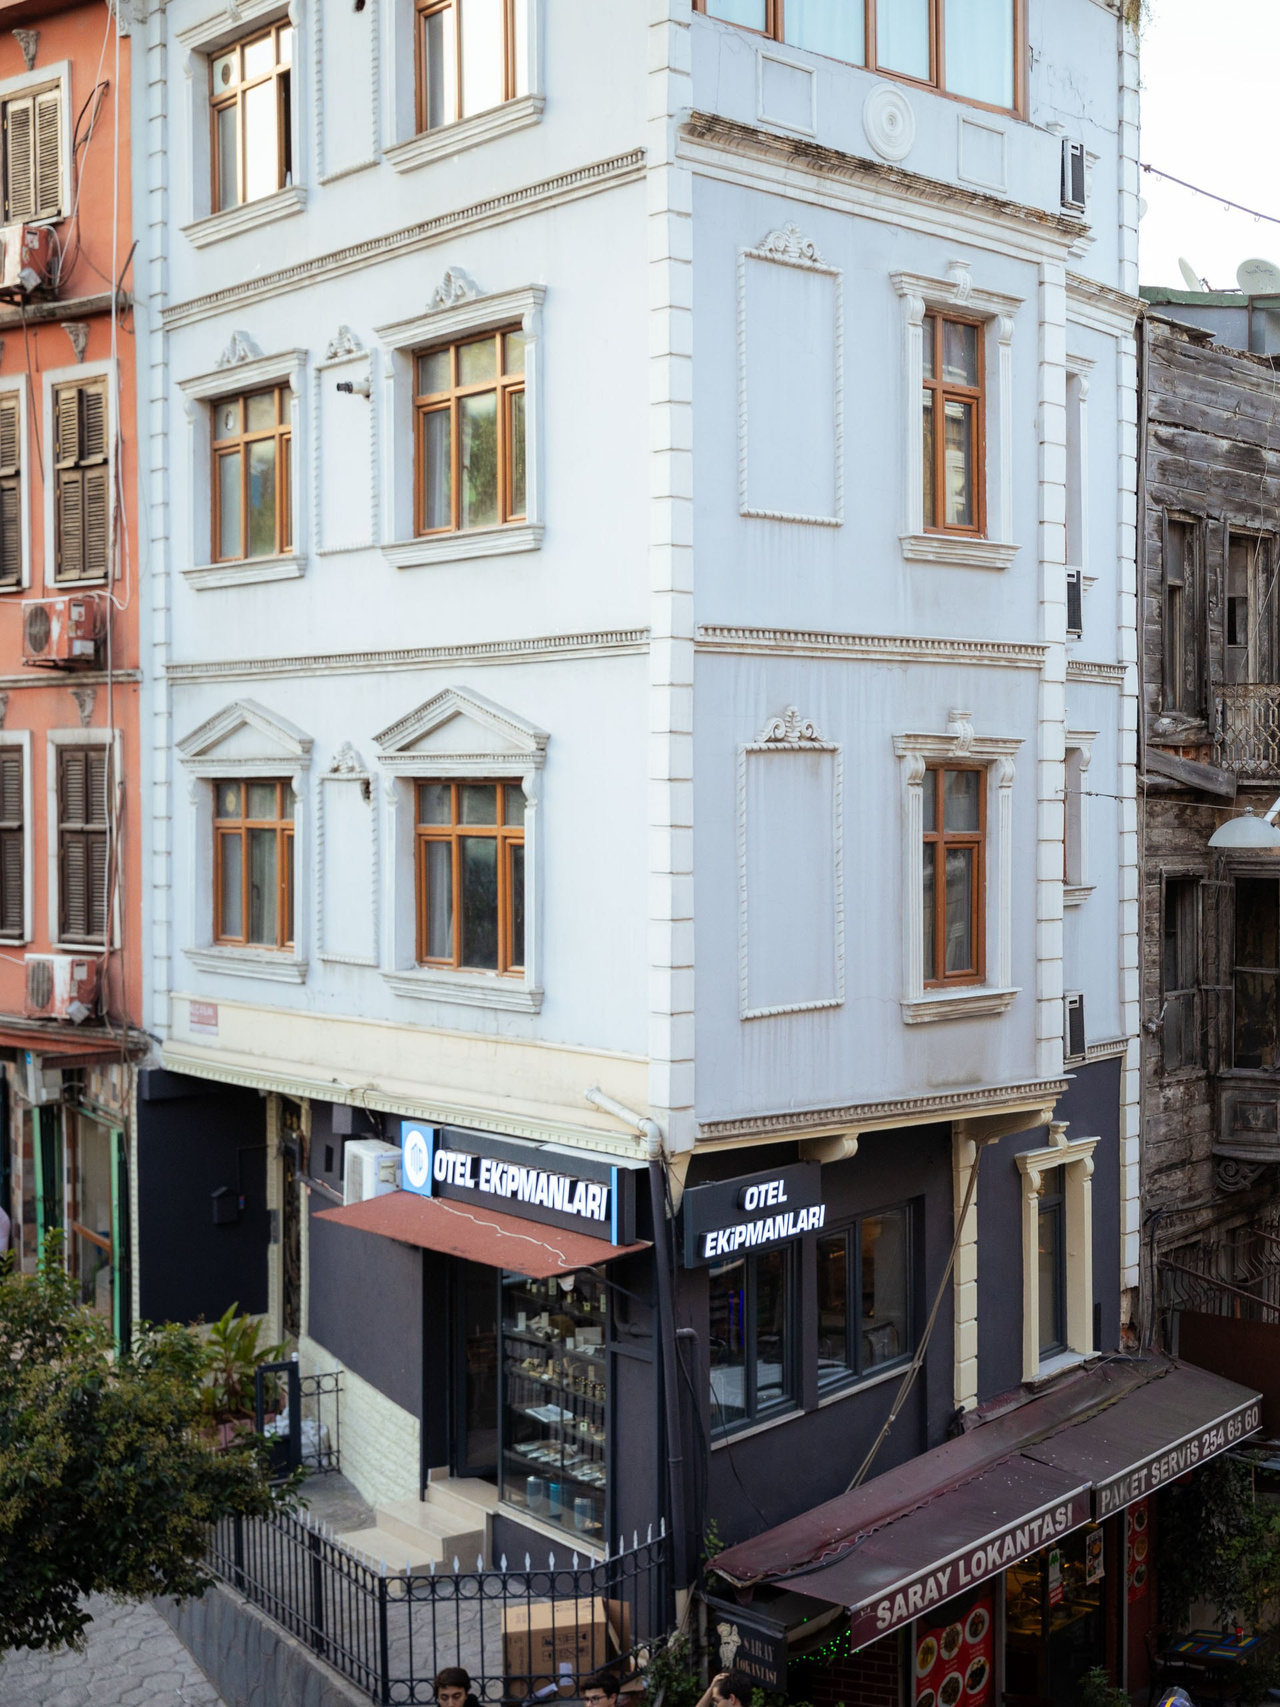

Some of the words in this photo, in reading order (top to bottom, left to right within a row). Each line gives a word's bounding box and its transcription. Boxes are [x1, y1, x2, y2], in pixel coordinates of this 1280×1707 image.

[433, 1149, 475, 1189] OTEL
[744, 1179, 788, 1211] OTEL
[1101, 1468, 1148, 1514] PAKET
[1202, 1427, 1225, 1456] 254
[1245, 1406, 1259, 1431] 60
[876, 1566, 952, 1630] SARAY
[958, 1502, 1073, 1586] LOKANTASI
